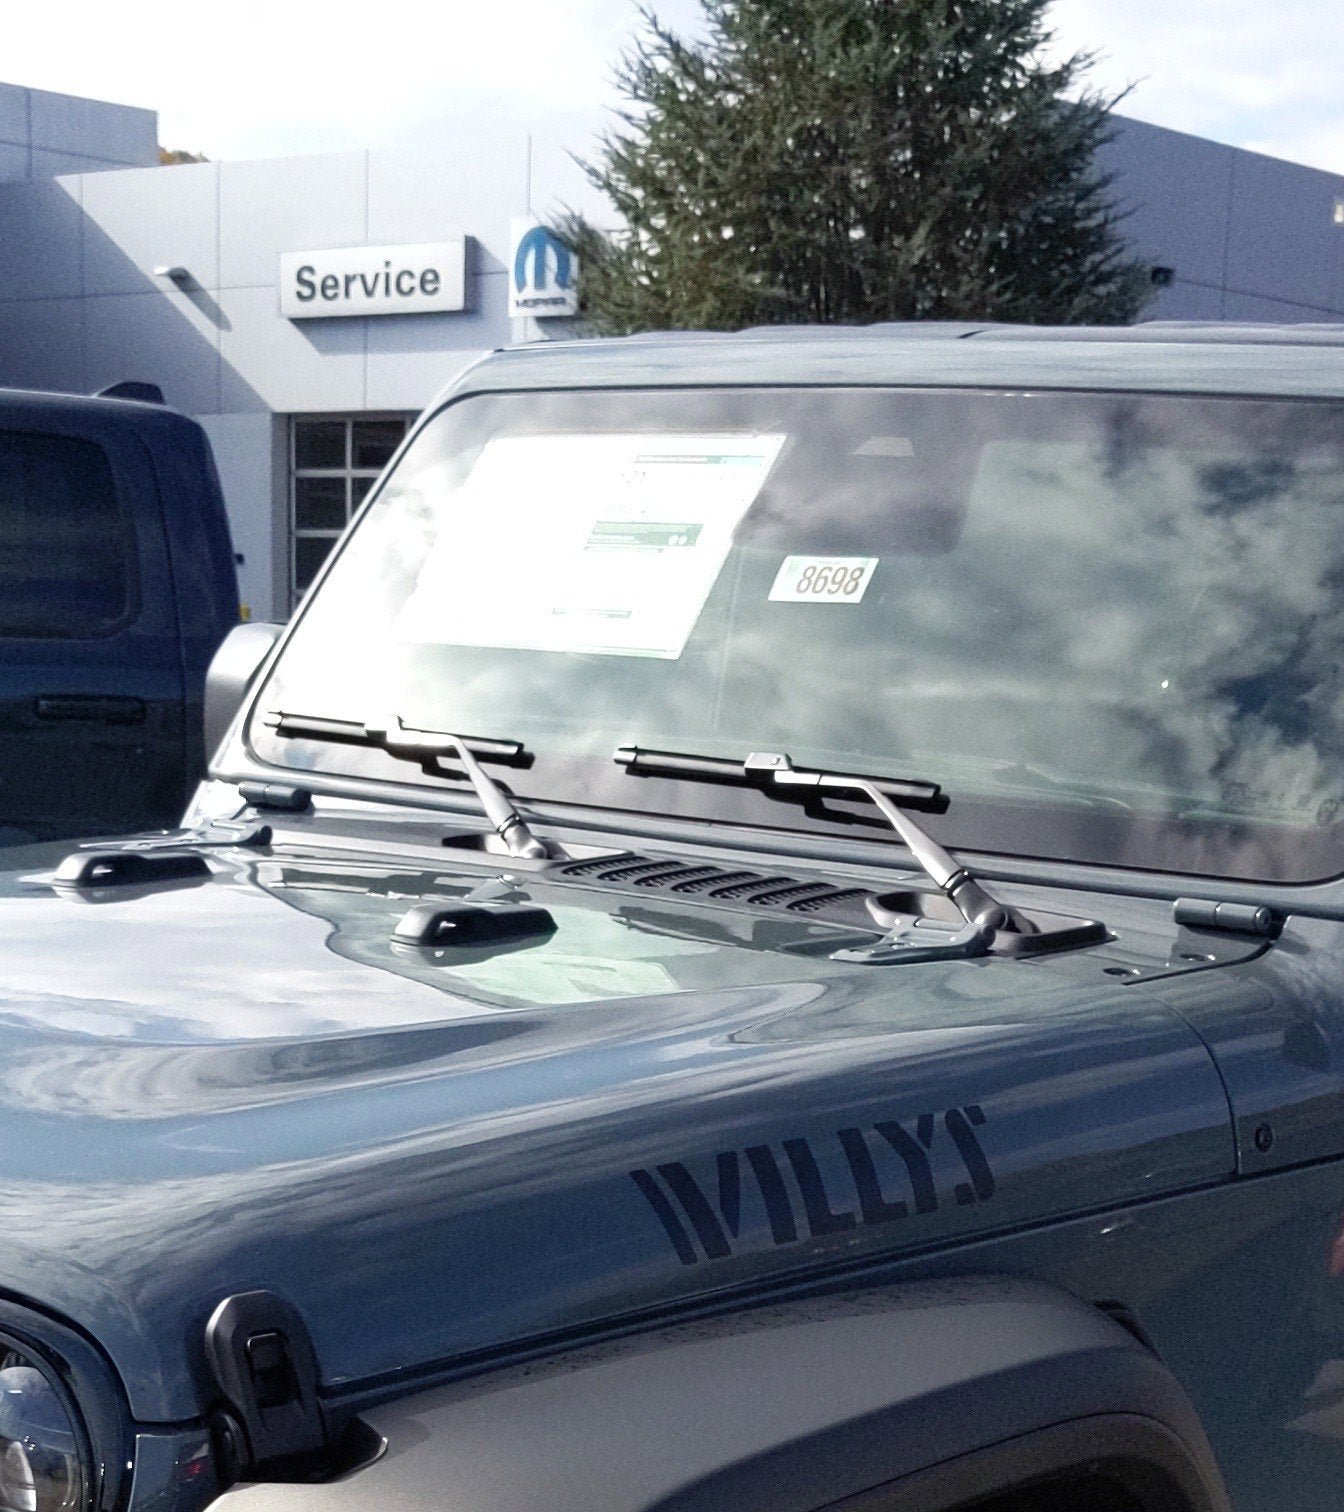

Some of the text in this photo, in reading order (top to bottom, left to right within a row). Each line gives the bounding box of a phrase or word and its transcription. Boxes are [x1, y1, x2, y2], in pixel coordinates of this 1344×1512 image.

[296, 260, 441, 301] Service
[796, 566, 865, 594] 8698
[629, 1105, 995, 1265] WILLYS
